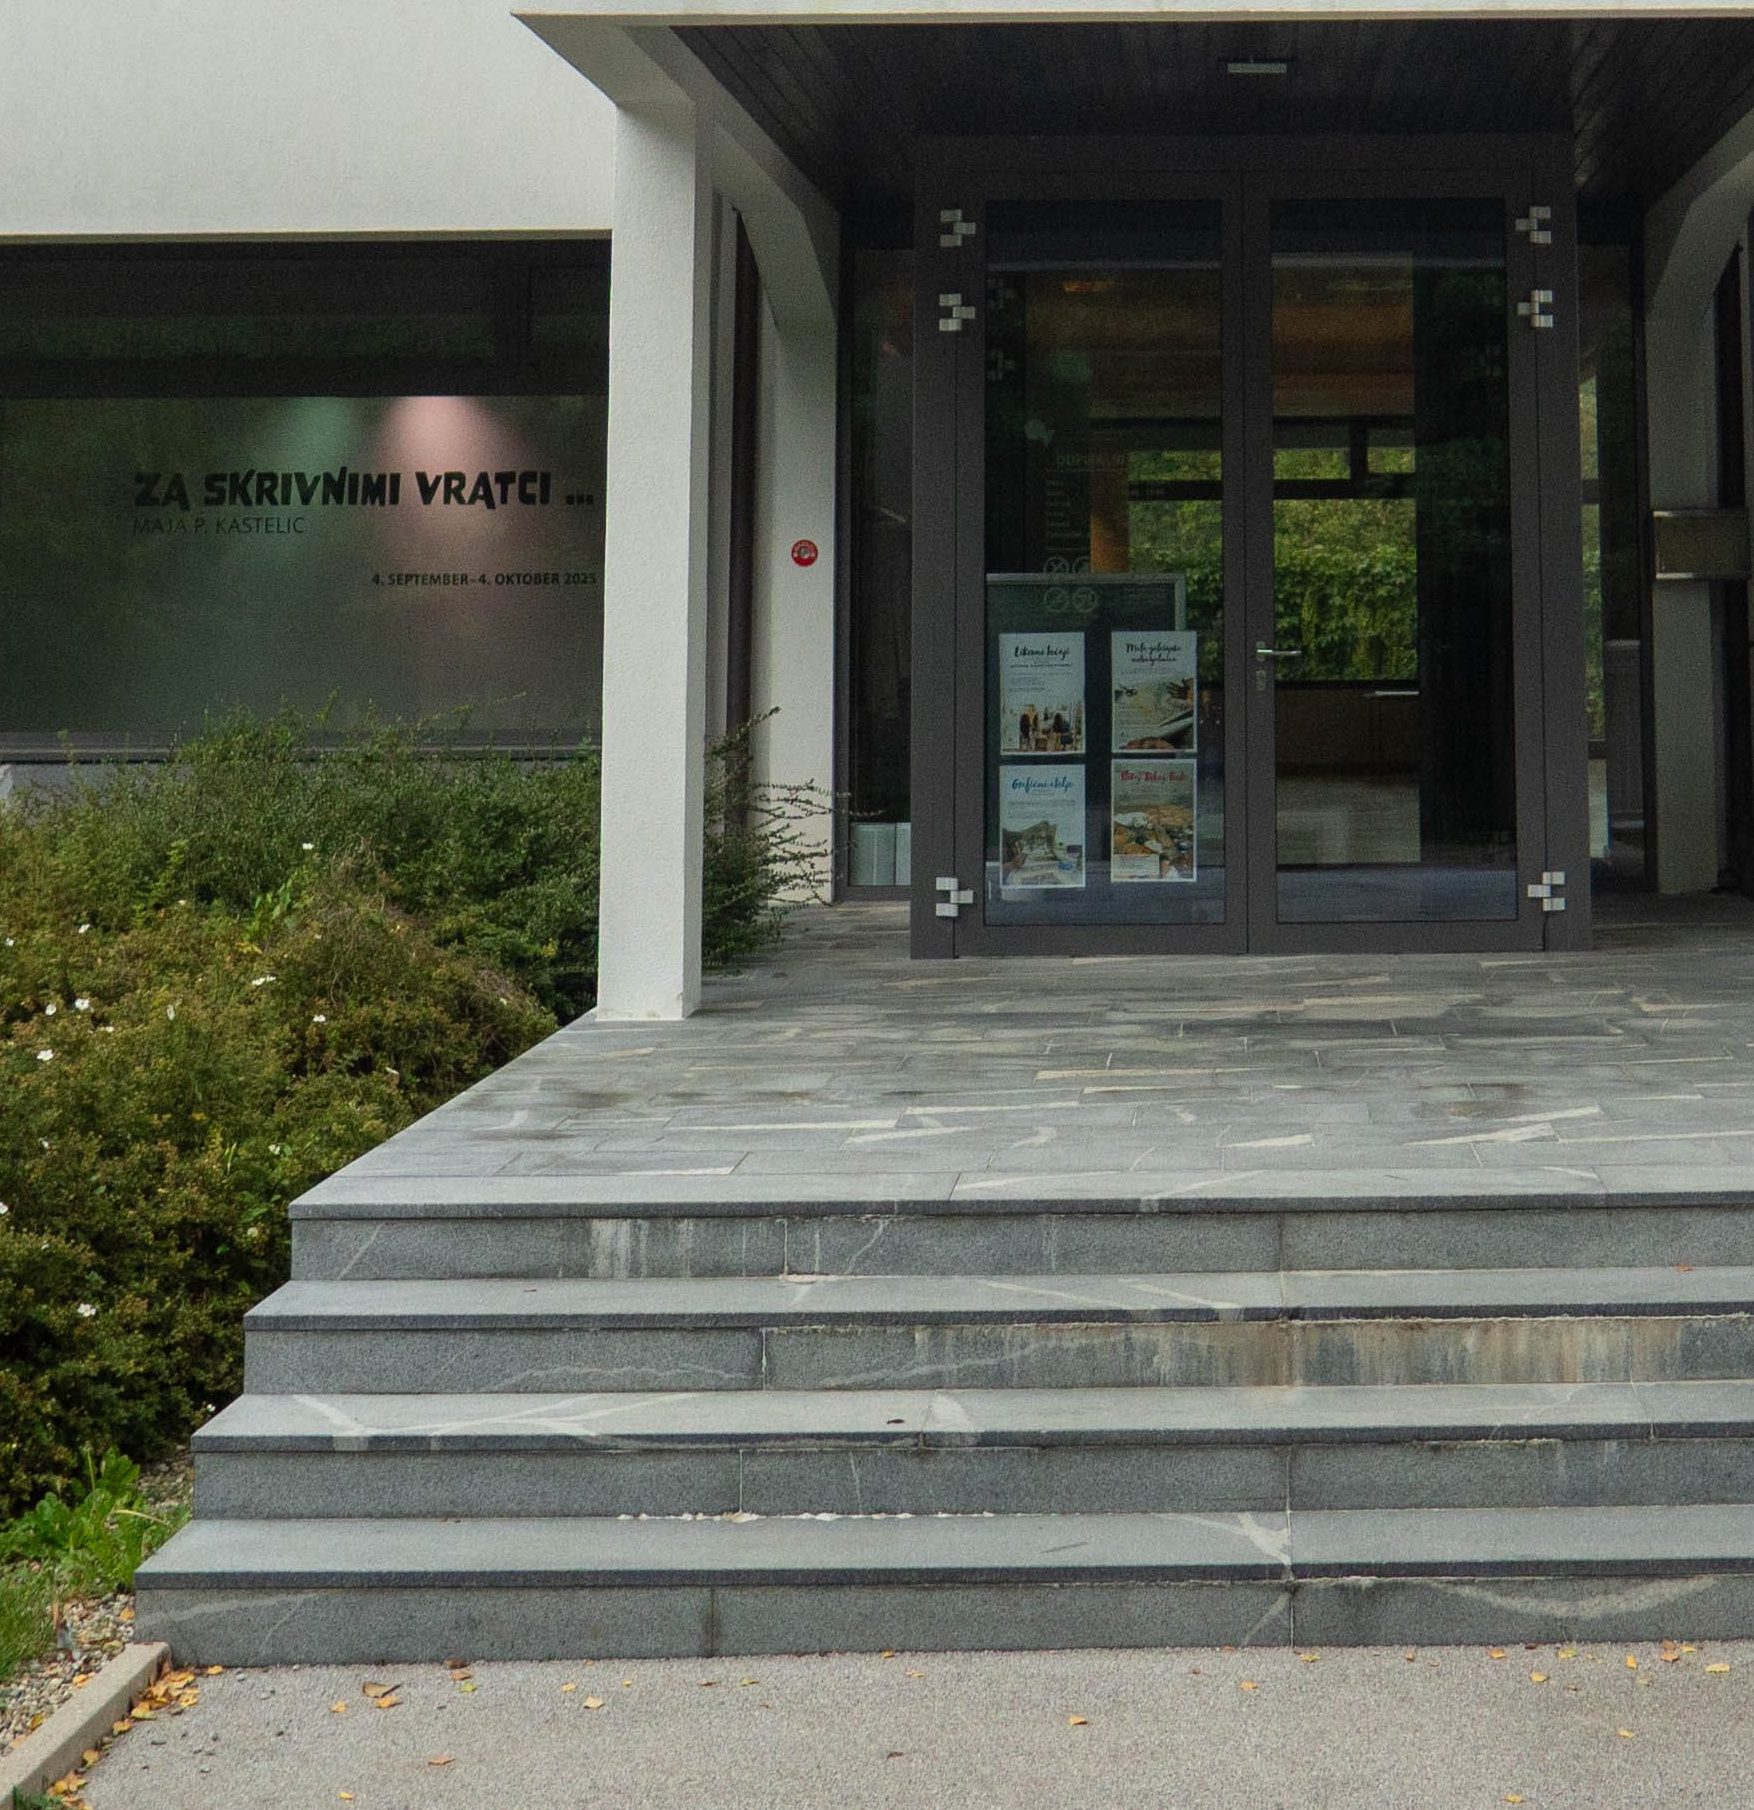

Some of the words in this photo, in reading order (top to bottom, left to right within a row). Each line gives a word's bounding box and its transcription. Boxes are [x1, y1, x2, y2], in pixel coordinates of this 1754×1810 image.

[135, 472, 190, 511] ZA
[204, 466, 400, 506] SKRIVNIMI
[415, 471, 551, 509] VRATCI
[133, 518, 187, 534] MAJA
[194, 518, 208, 534] P.
[215, 516, 306, 534] KASTELIC
[494, 572, 560, 587] OKTOBER
[564, 572, 597, 585] 2025
